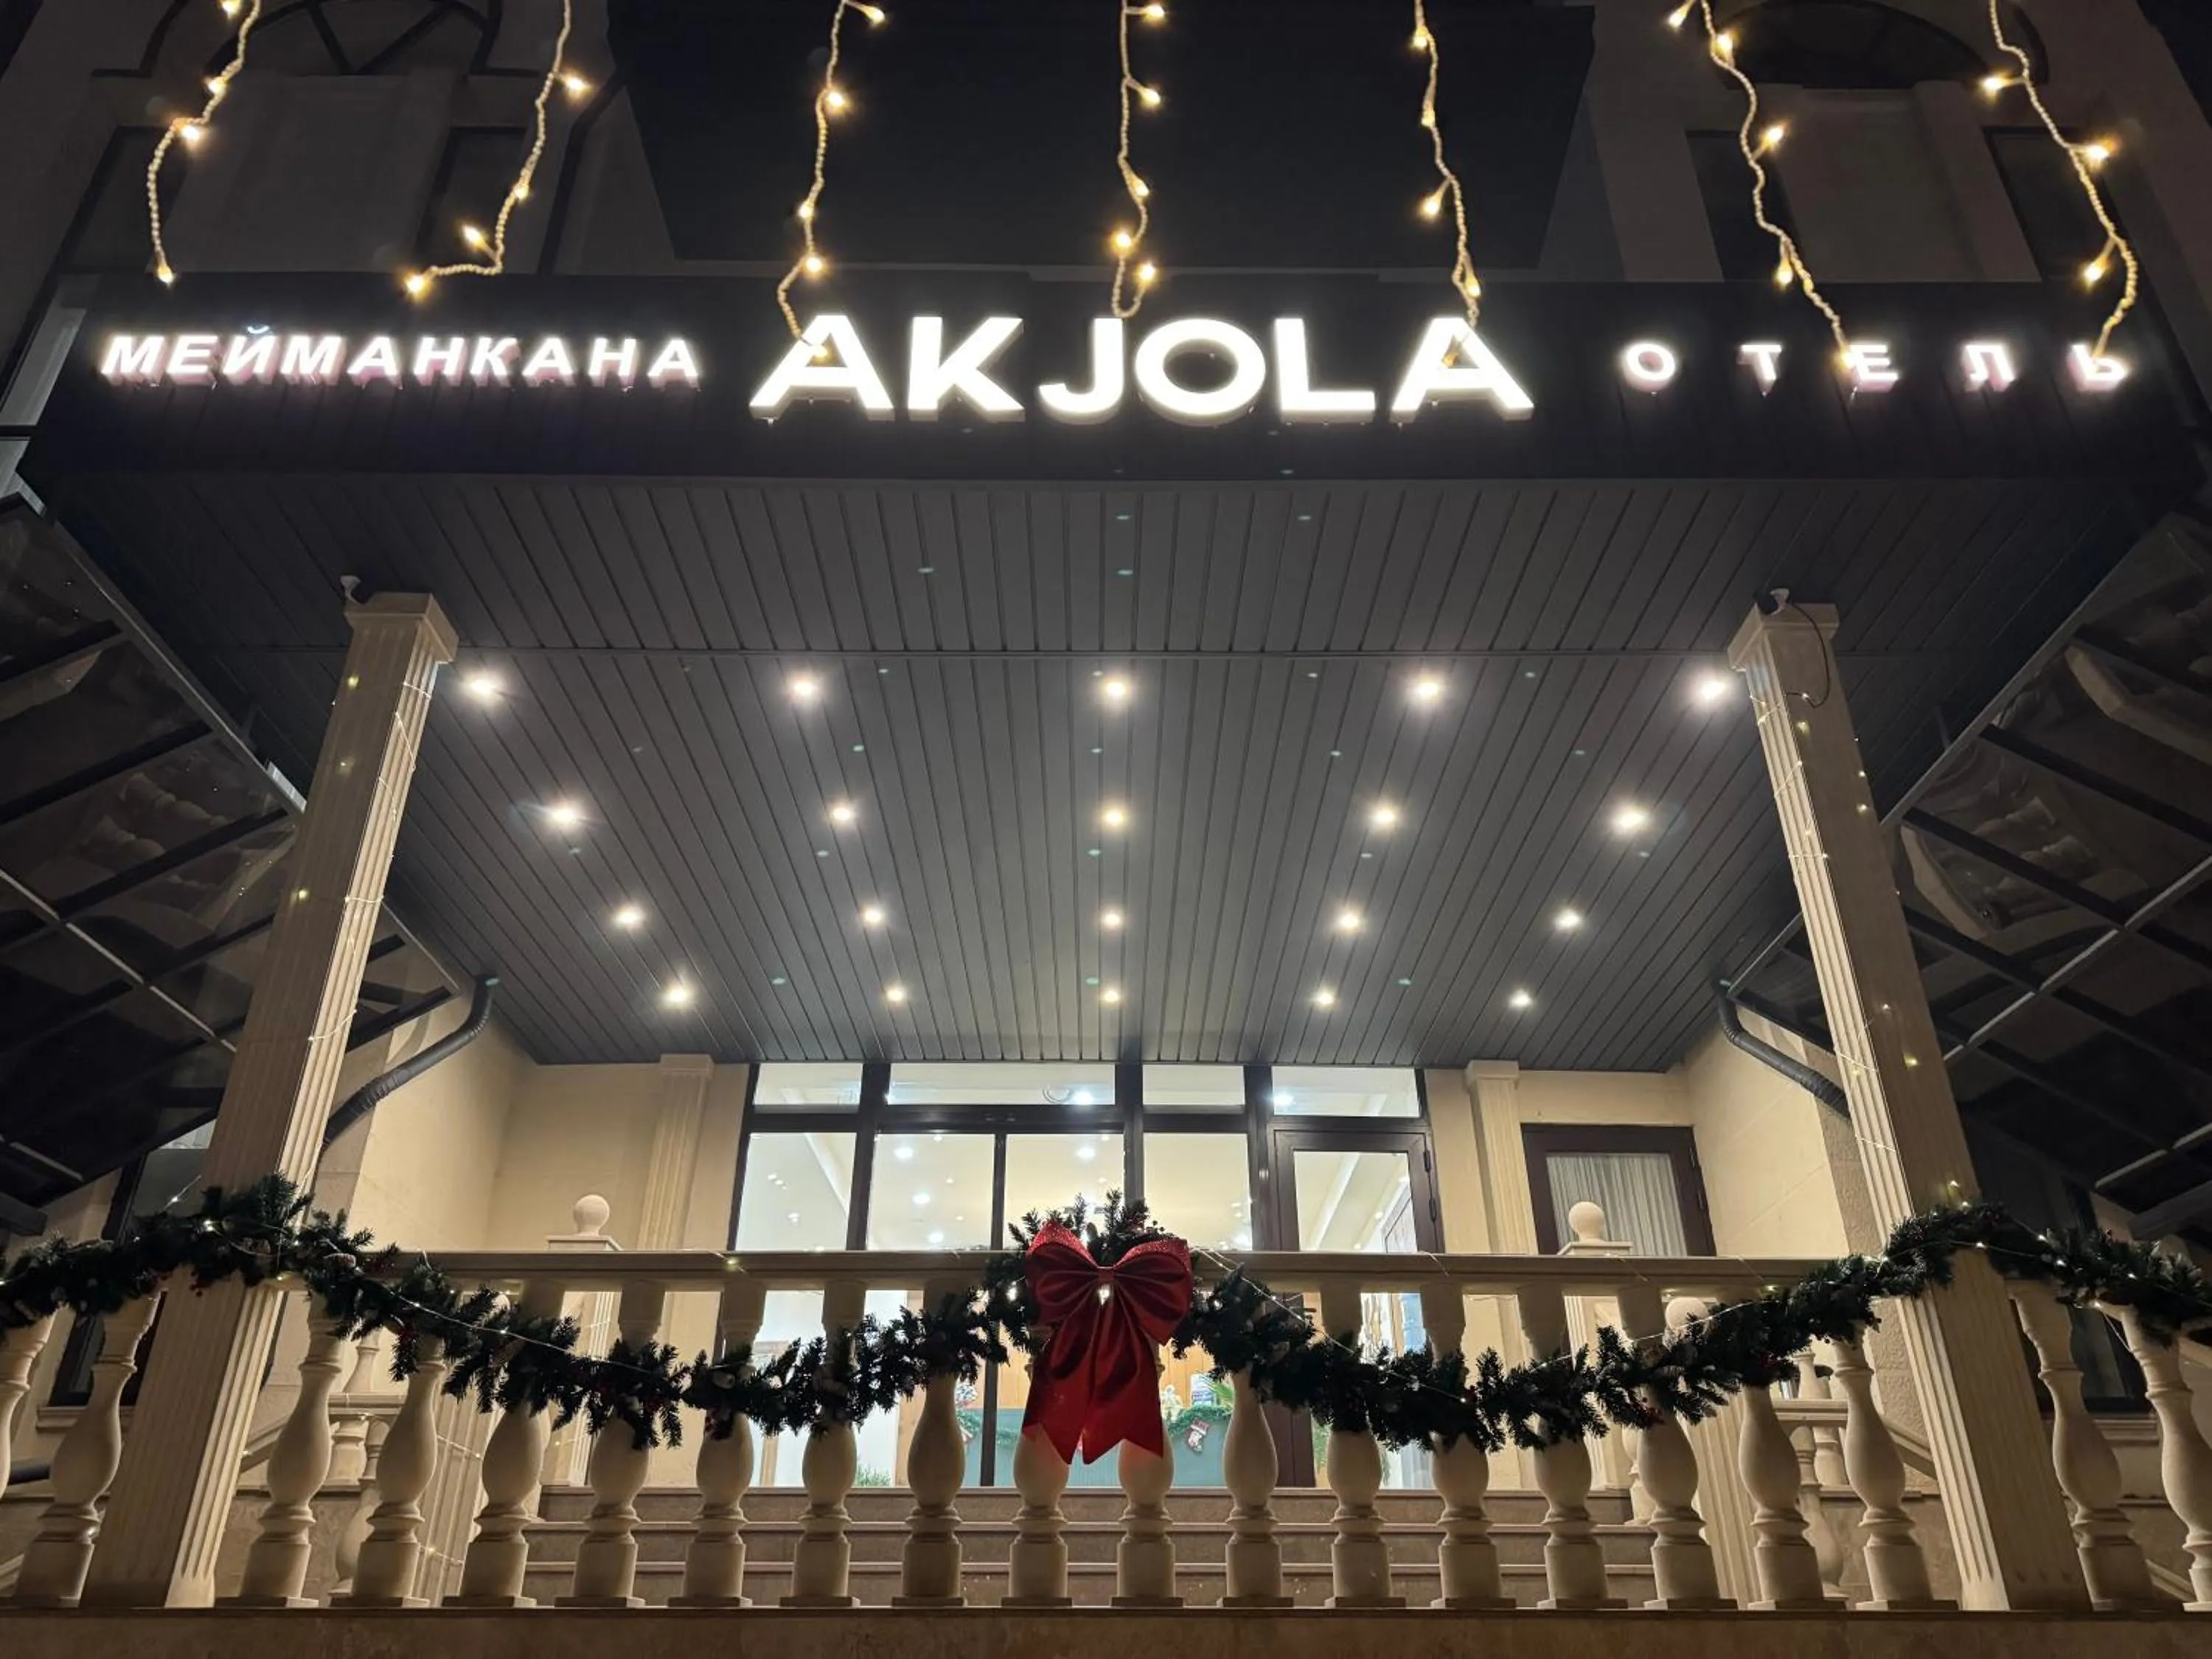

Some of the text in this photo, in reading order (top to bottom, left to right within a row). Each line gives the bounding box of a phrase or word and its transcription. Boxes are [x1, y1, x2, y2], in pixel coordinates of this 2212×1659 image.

[100, 326, 700, 383] МЕЙМАНКАНА
[749, 314, 1534, 417] AKJOLA
[1622, 341, 2130, 388] ОТЕЛЬ
